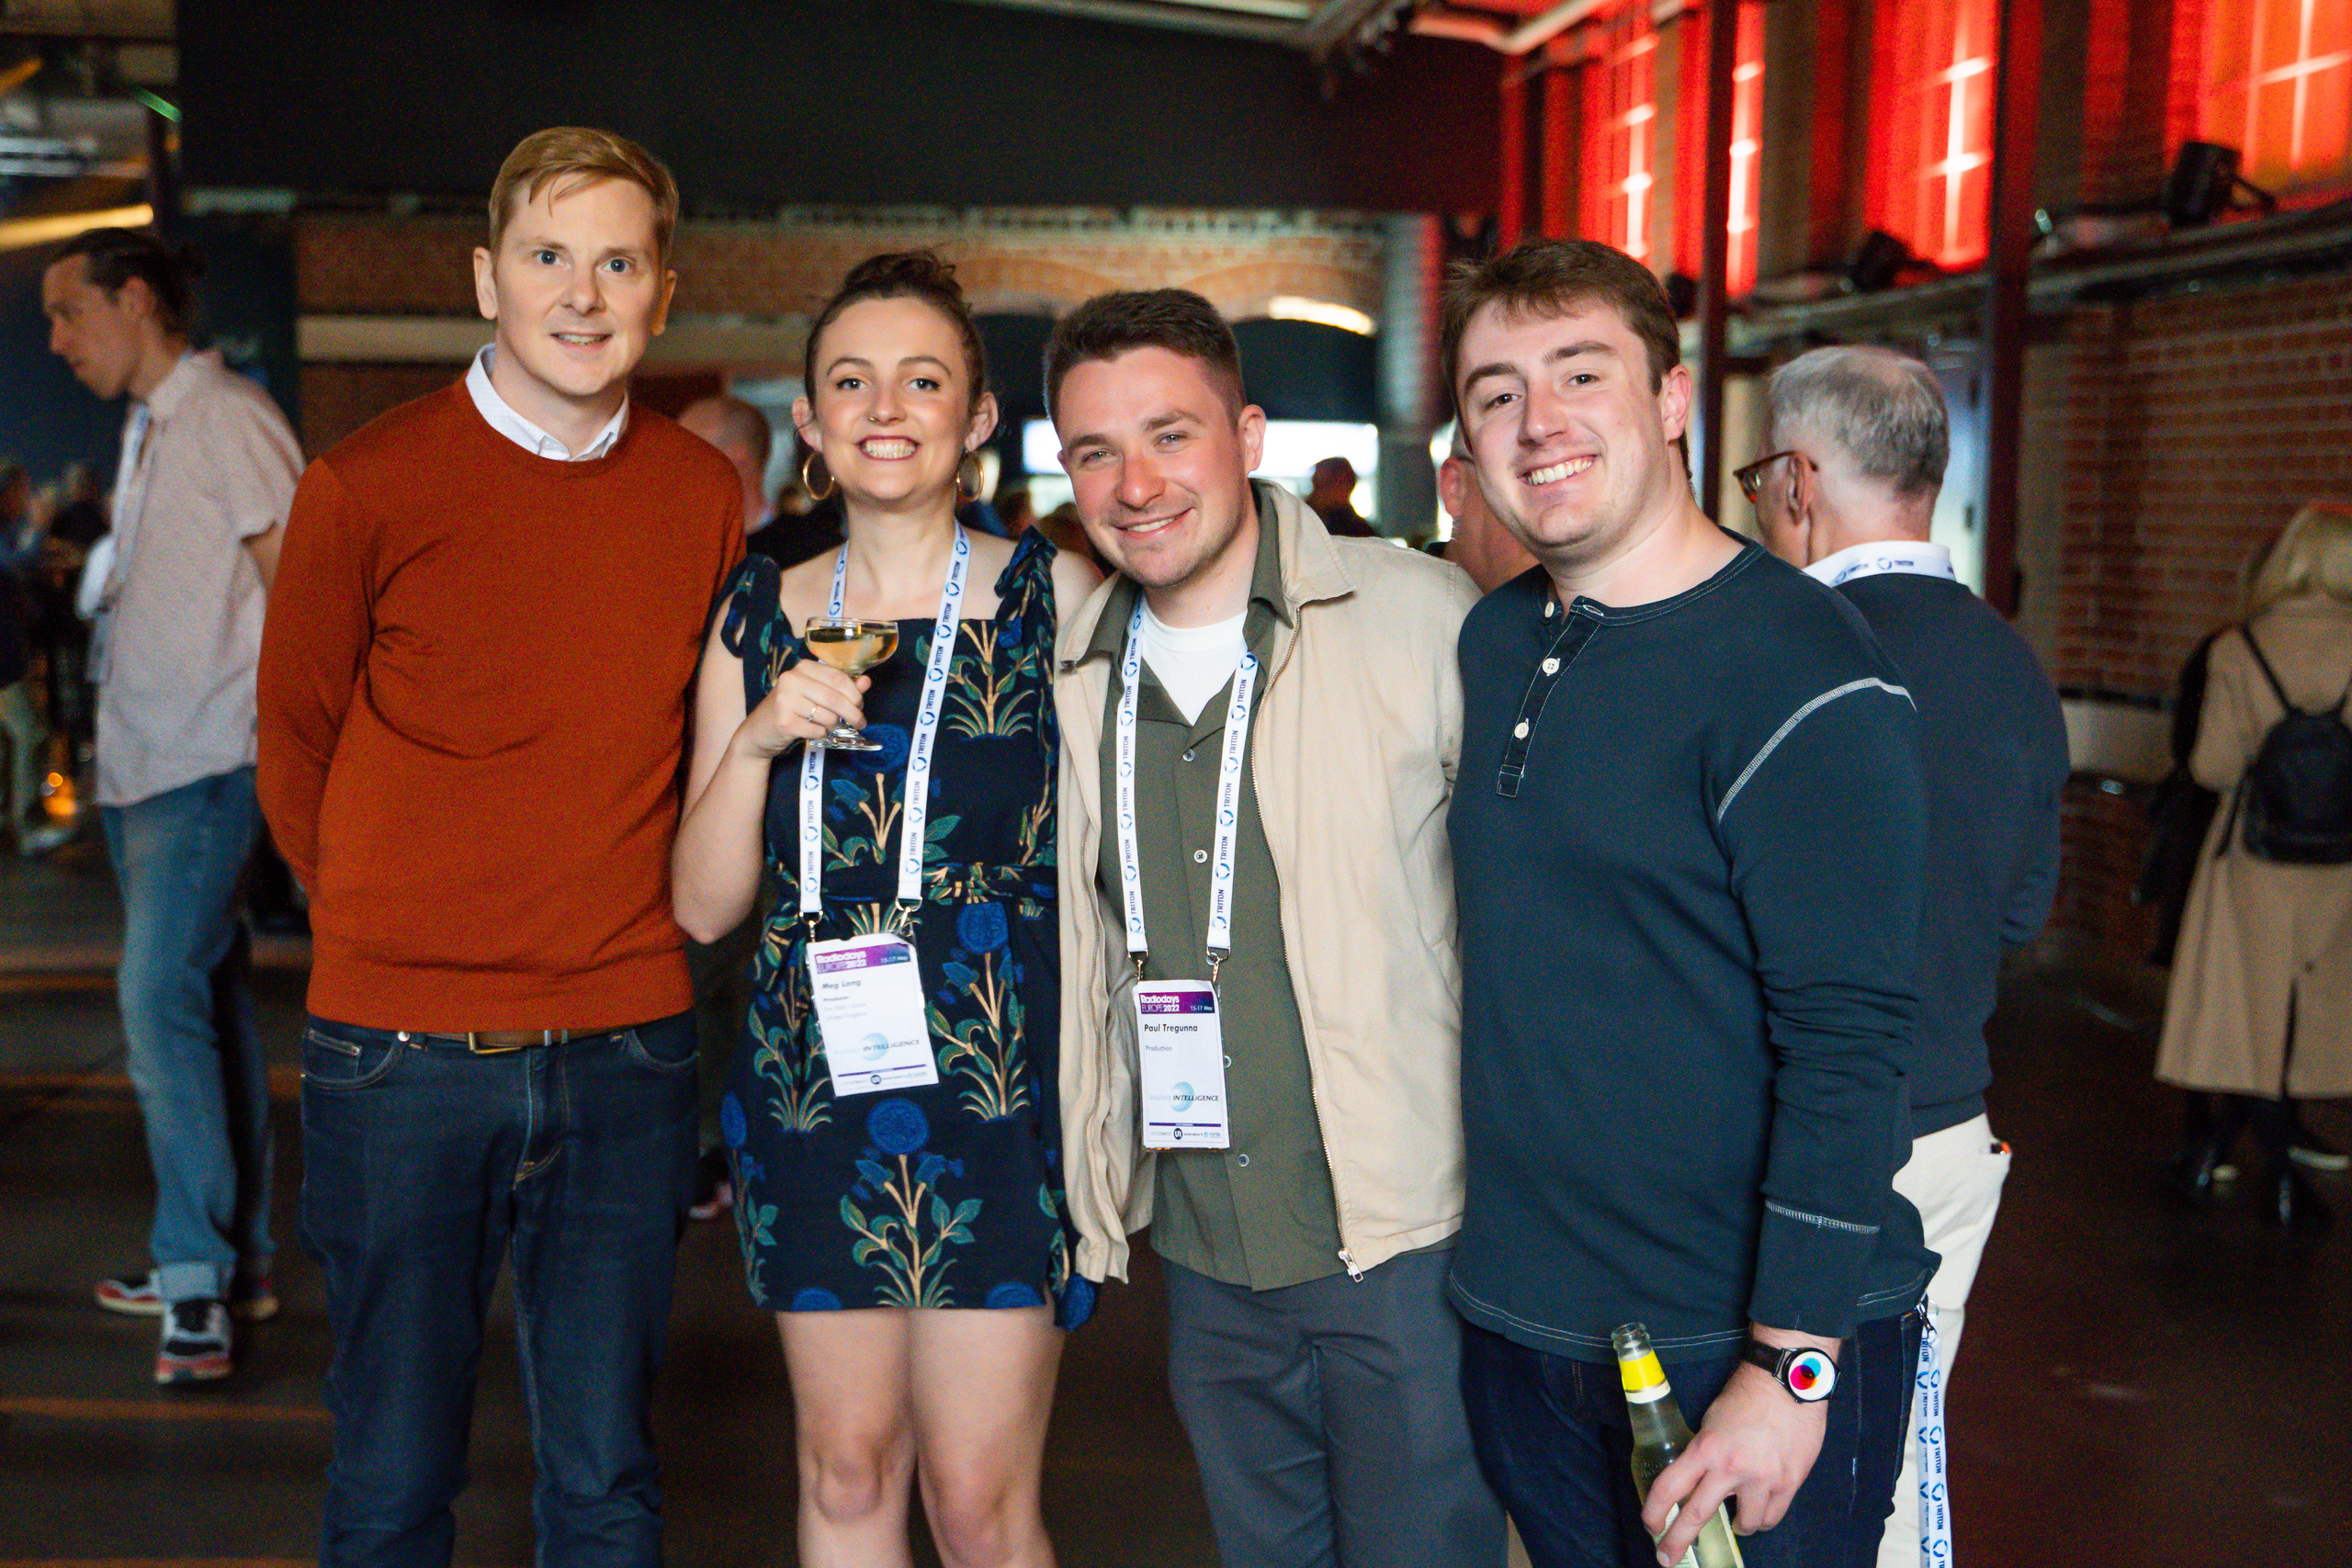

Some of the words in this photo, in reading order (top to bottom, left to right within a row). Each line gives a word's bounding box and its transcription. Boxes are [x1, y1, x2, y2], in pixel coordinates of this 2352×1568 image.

[952, 560, 961, 581] TRITON
[942, 603, 952, 623] TRITON
[934, 646, 944, 666] TRITON
[926, 690, 935, 710] TRITON
[1238, 679, 1247, 703] TRITON
[918, 733, 927, 754] TRITON
[1229, 729, 1238, 755] TRITON
[808, 751, 817, 773] TRITON
[1224, 783, 1232, 807] TRITON
[910, 832, 918, 855] TRITON
[1220, 836, 1228, 861] TRITON
[1216, 889, 1225, 914] TRITON
[1140, 995, 1180, 1004] Radiodays
[1162, 1024, 1198, 1033] Tregunna
[1921, 1337, 1929, 1362] TRITON
[1936, 1504, 1944, 1530] TRITON
